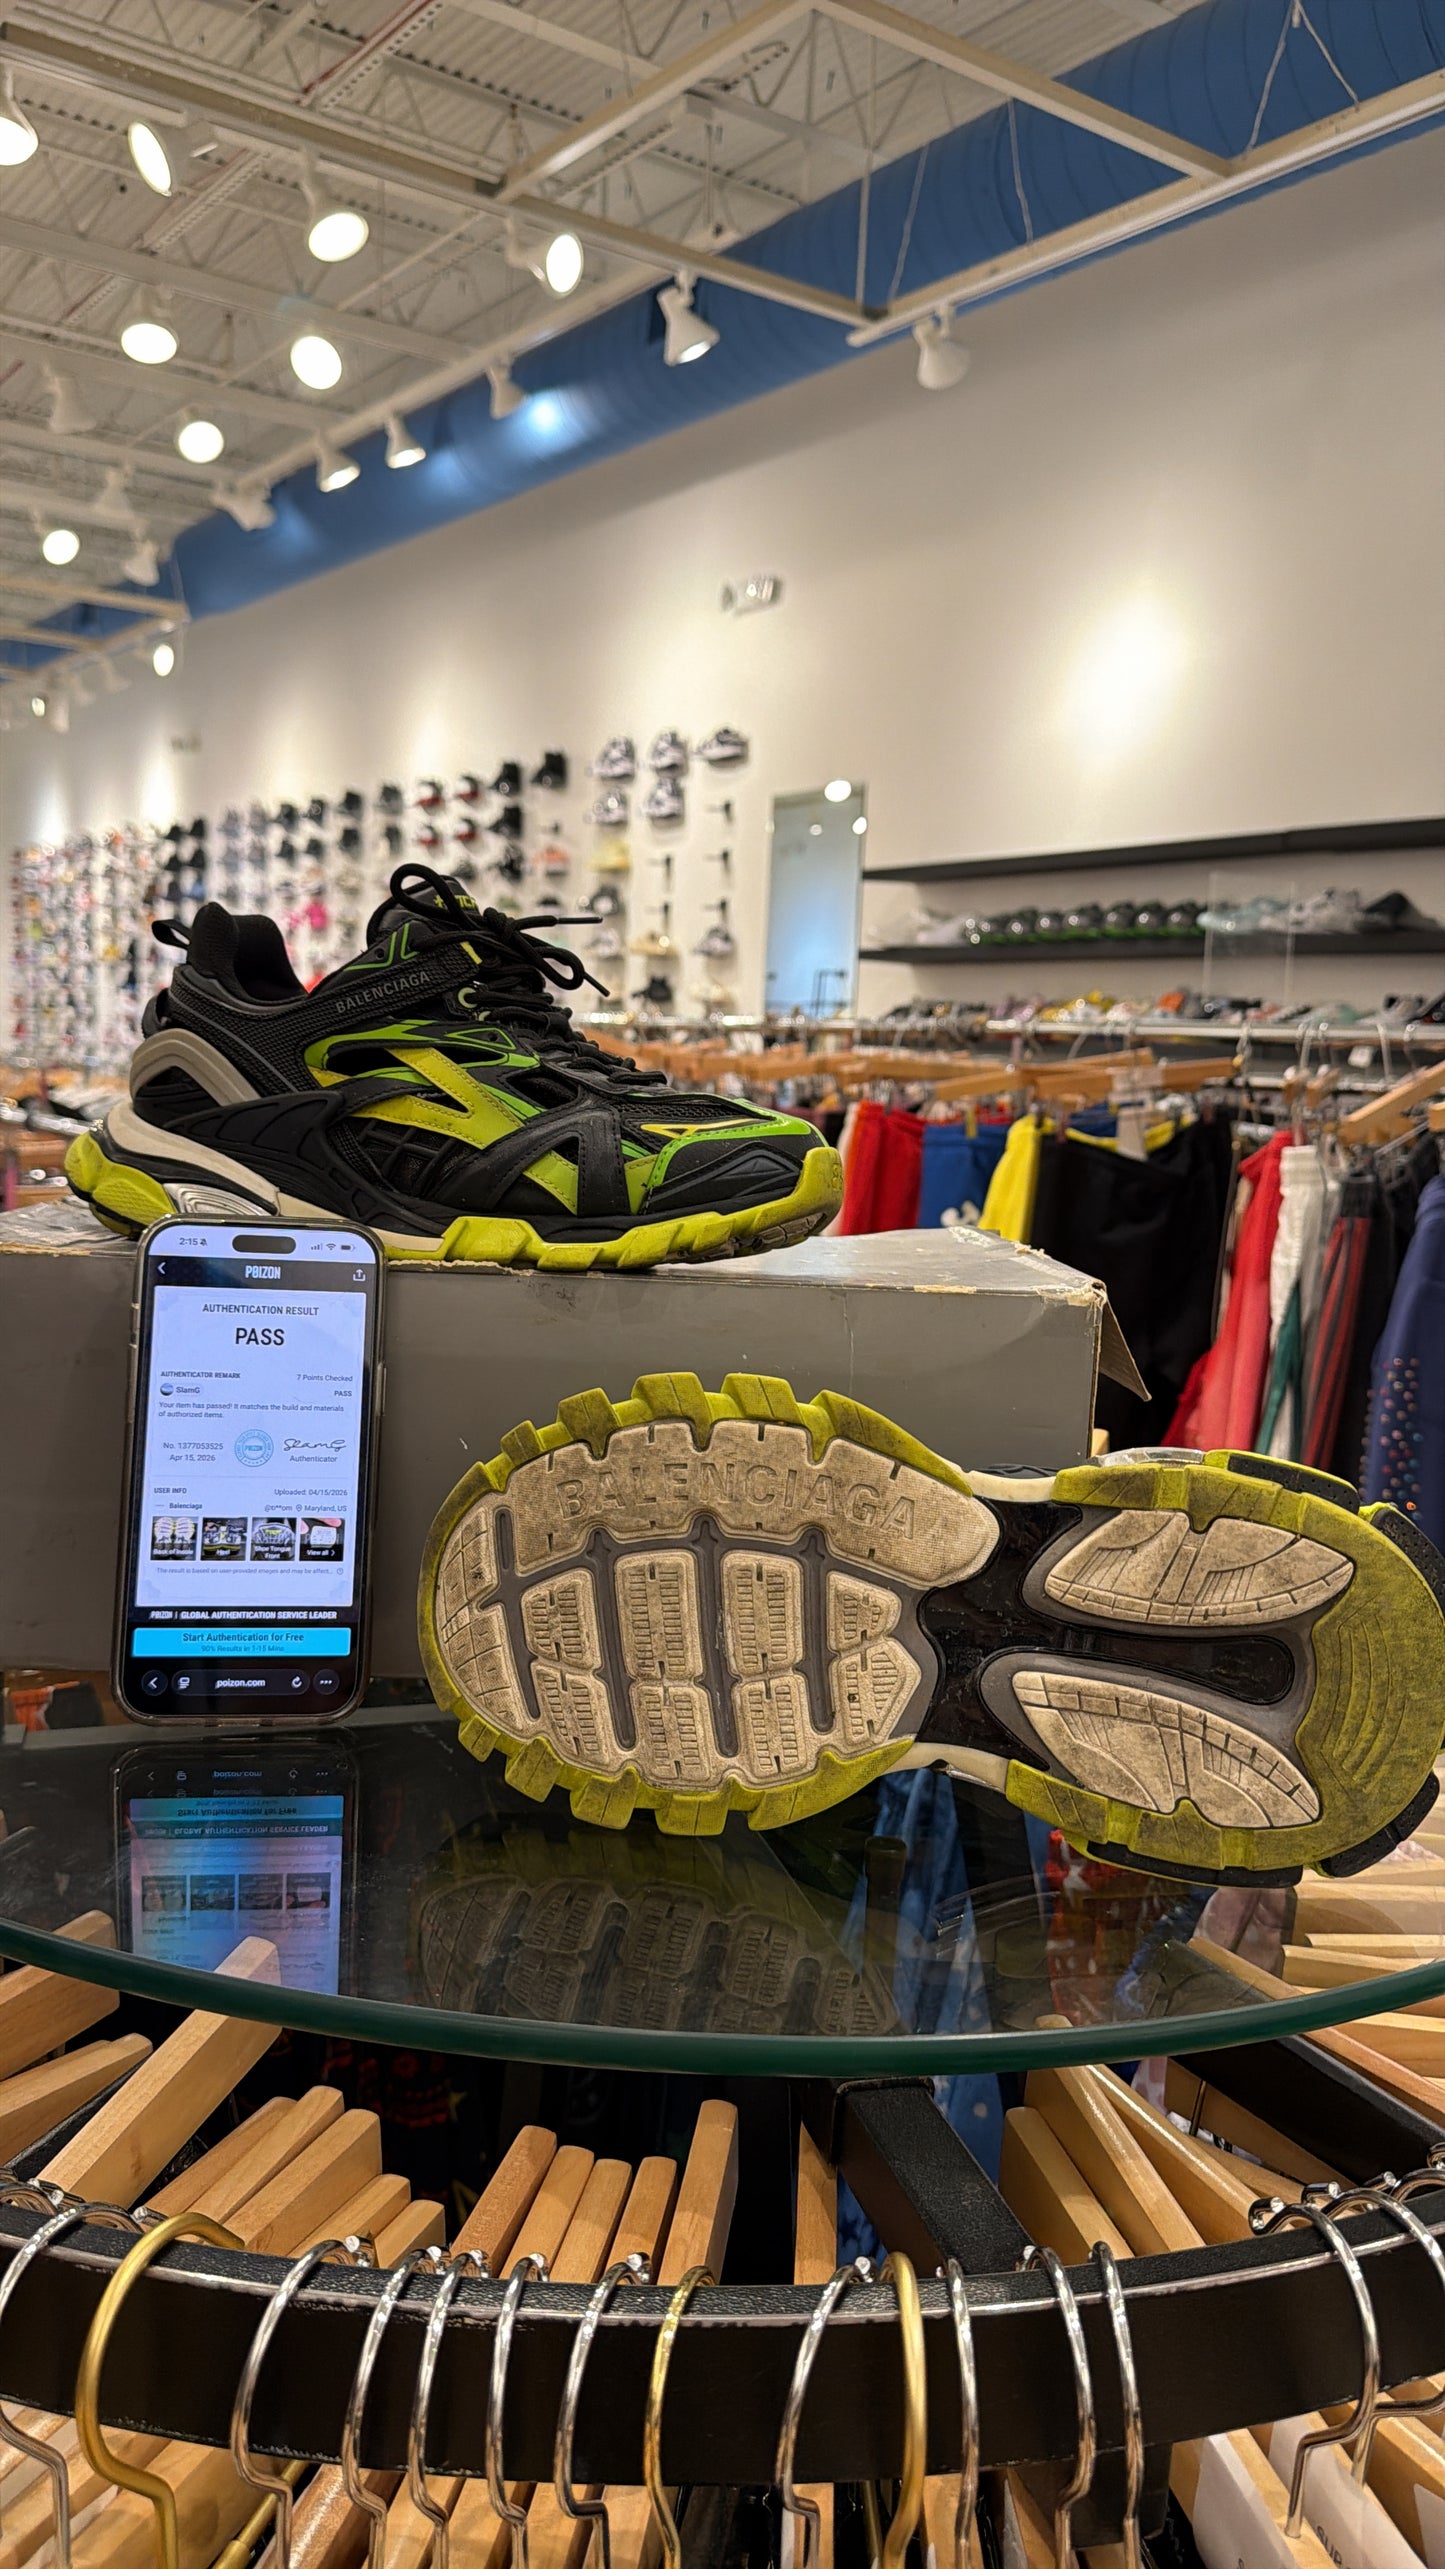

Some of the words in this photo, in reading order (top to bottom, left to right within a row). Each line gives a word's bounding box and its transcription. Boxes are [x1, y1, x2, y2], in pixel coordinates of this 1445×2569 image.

[335, 971, 430, 1013] BALENCIAGA
[179, 1237, 199, 1246] 2:15
[245, 1265, 281, 1279] POIZON
[202, 1304, 283, 1315] AUTHENTICATION
[285, 1306, 319, 1316] RESULT
[235, 1327, 285, 1346] PASS
[169, 1454, 183, 1462] Apr
[197, 1454, 216, 1462] 2026
[289, 1455, 338, 1463] Authenticator
[169, 1502, 203, 1510] Balenciaga
[554, 1462, 916, 1542] BALENCIAGA
[181, 1611, 210, 1619] GLOBAL
[211, 1611, 276, 1620] AUTHENTICATION
[277, 1611, 308, 1620] SERVICE
[309, 1611, 338, 1620] LEADER
[183, 1633, 204, 1642] Start
[206, 1633, 269, 1642] Authentication
[271, 1633, 284, 1642] for
[286, 1633, 305, 1642] Free
[216, 1678, 266, 1689] poizon.com
